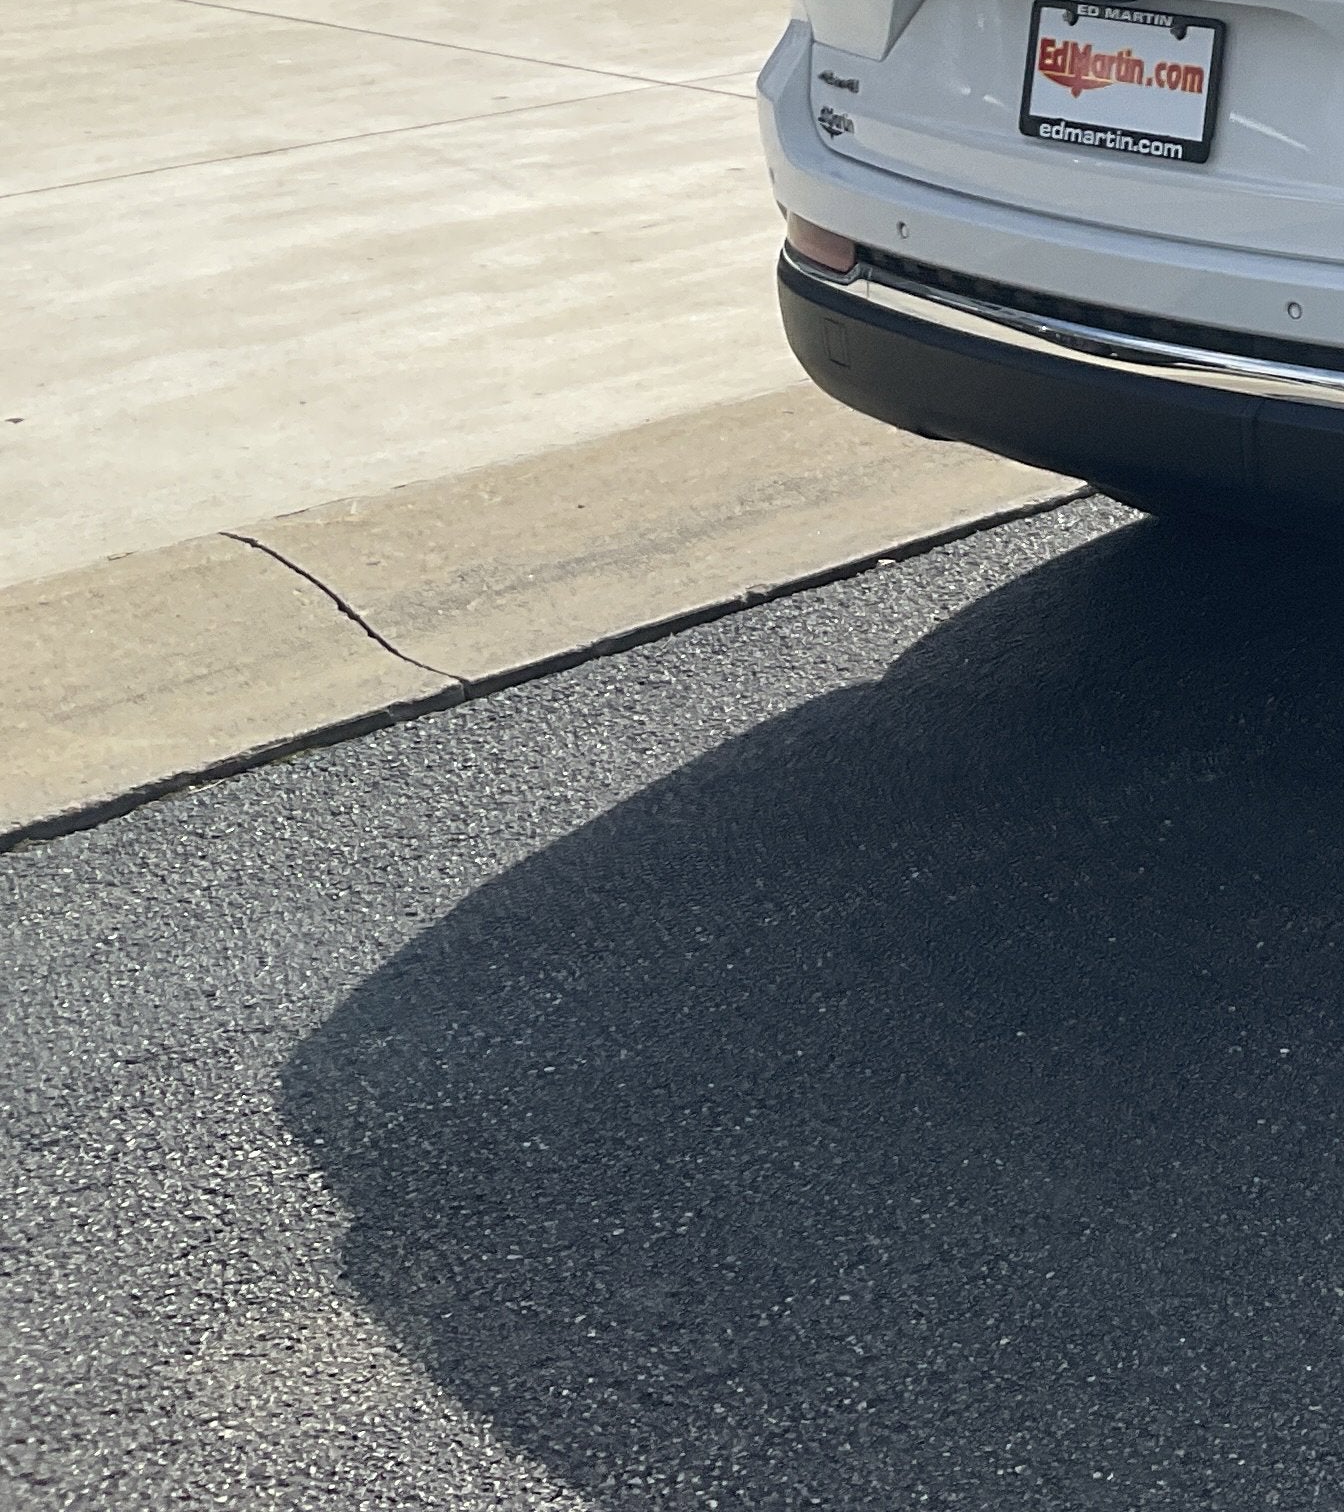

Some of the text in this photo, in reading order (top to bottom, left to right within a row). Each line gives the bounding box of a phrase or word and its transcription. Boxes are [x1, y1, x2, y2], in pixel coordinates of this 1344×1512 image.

[1077, 4, 1173, 27] ED MARTIN
[1038, 36, 1205, 94] EdMartin.com
[1039, 121, 1183, 159] edmartin.com
